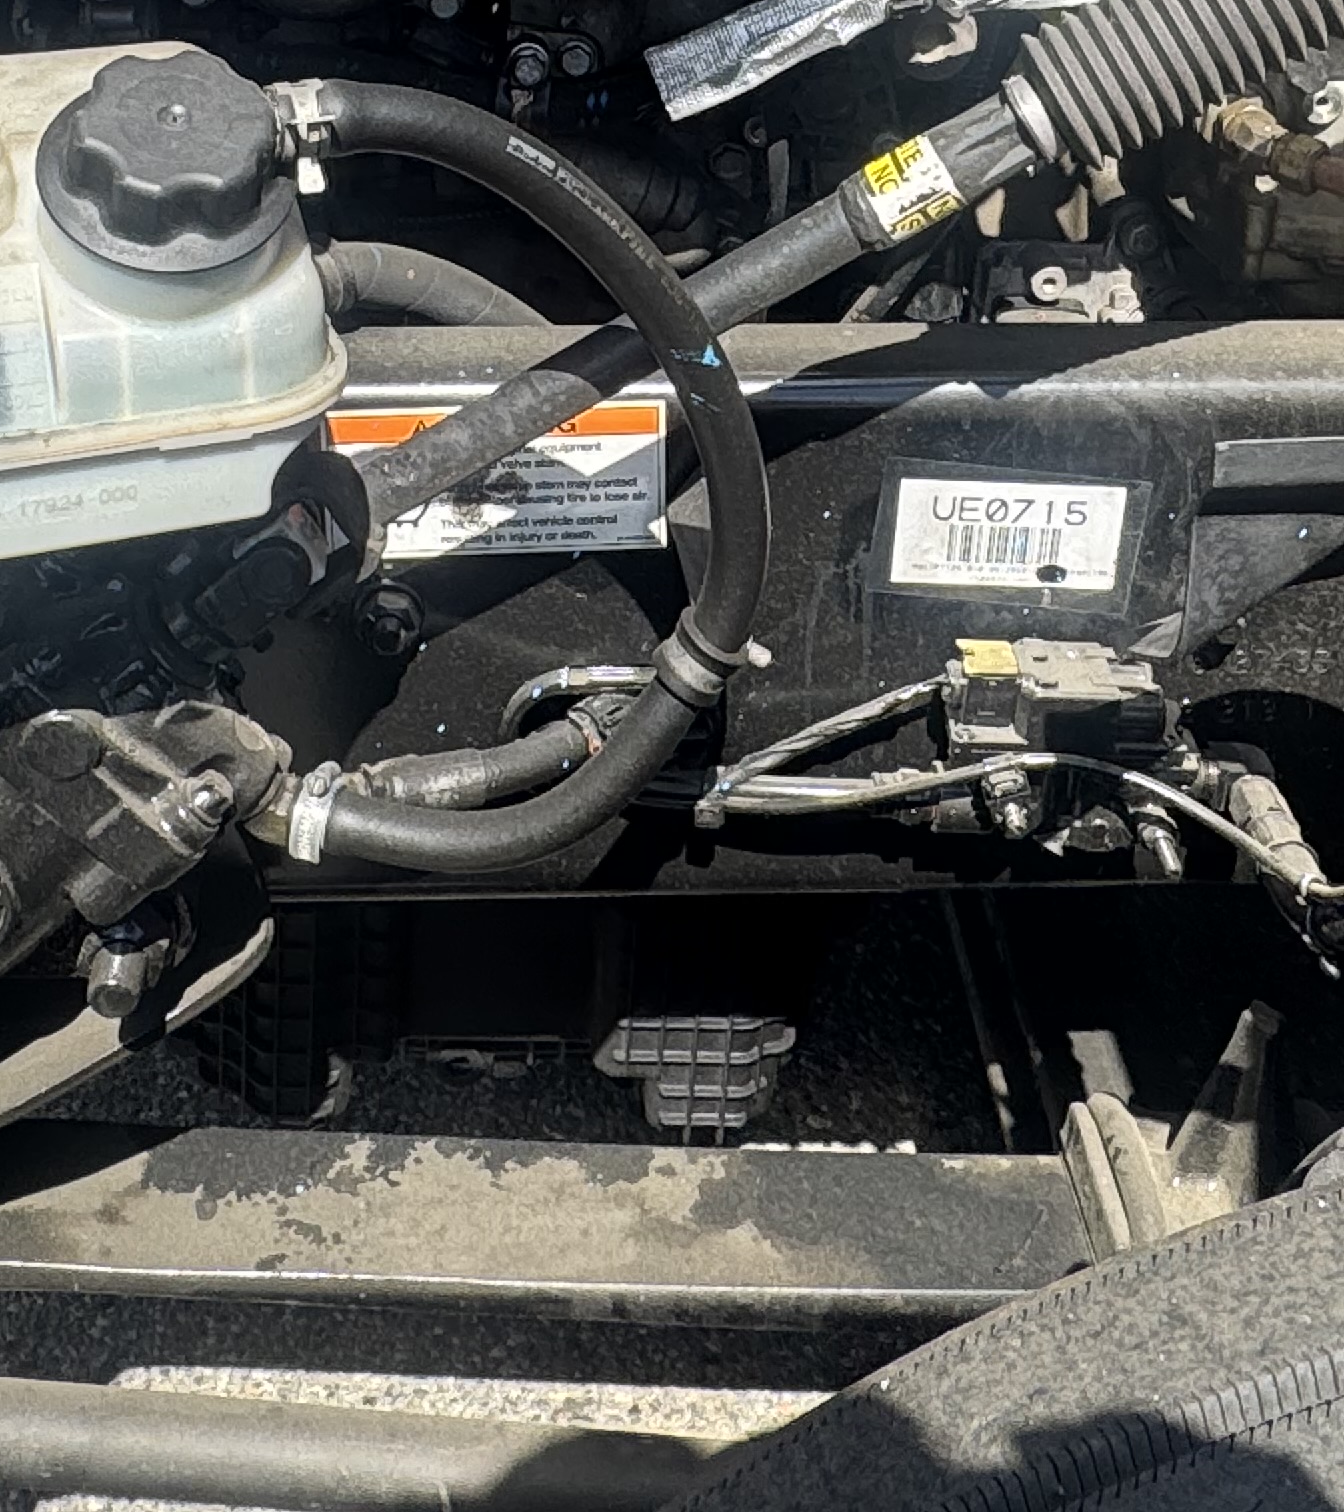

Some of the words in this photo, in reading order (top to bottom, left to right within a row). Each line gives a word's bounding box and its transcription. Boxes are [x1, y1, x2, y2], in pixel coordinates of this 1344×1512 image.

[566, 479, 592, 492] may
[931, 494, 1089, 526] UE0715
[530, 514, 574, 528] vehicle
[576, 513, 618, 526] control
[509, 530, 543, 544] injury
